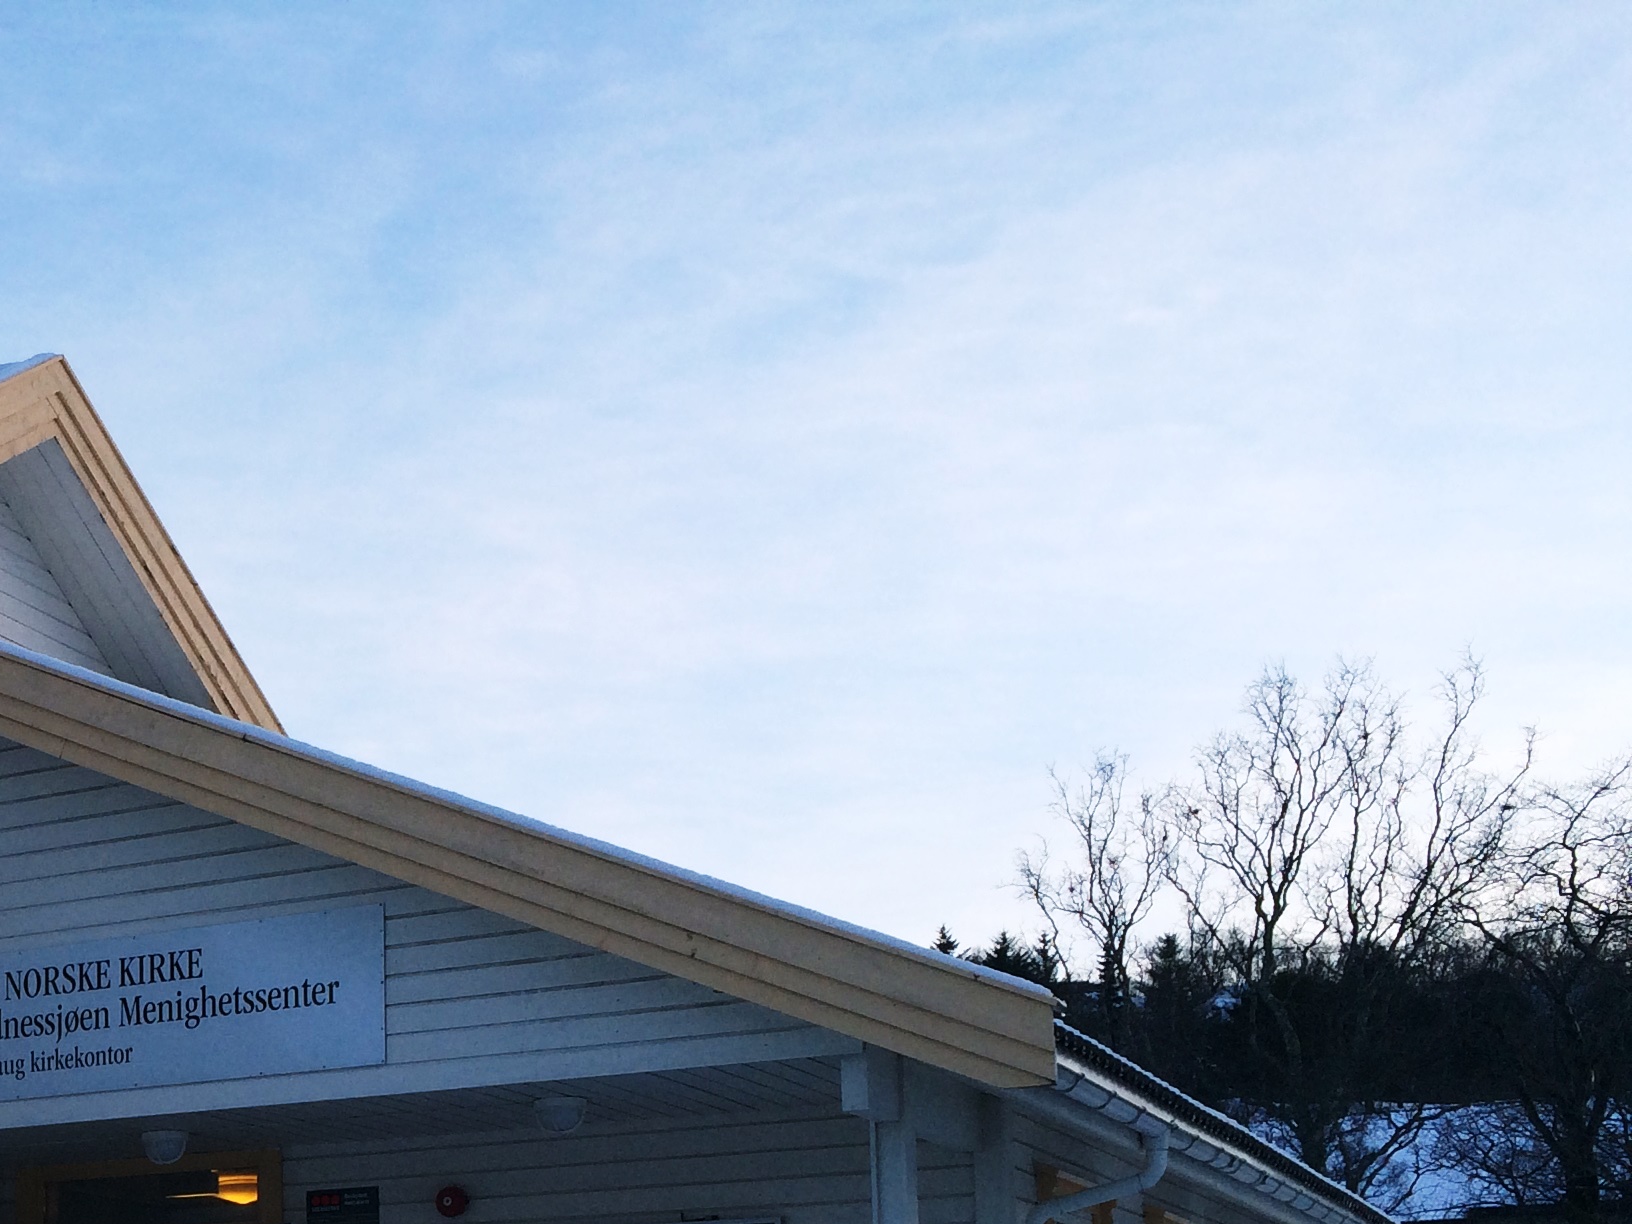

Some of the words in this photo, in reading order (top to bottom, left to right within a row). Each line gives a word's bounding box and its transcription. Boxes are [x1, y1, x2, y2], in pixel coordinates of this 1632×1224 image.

[4, 959, 112, 1001] NORSKE
[119, 948, 204, 988] KIRKE
[118, 978, 340, 1030] Menighetssenter
[30, 1045, 134, 1073] kirkekontor
